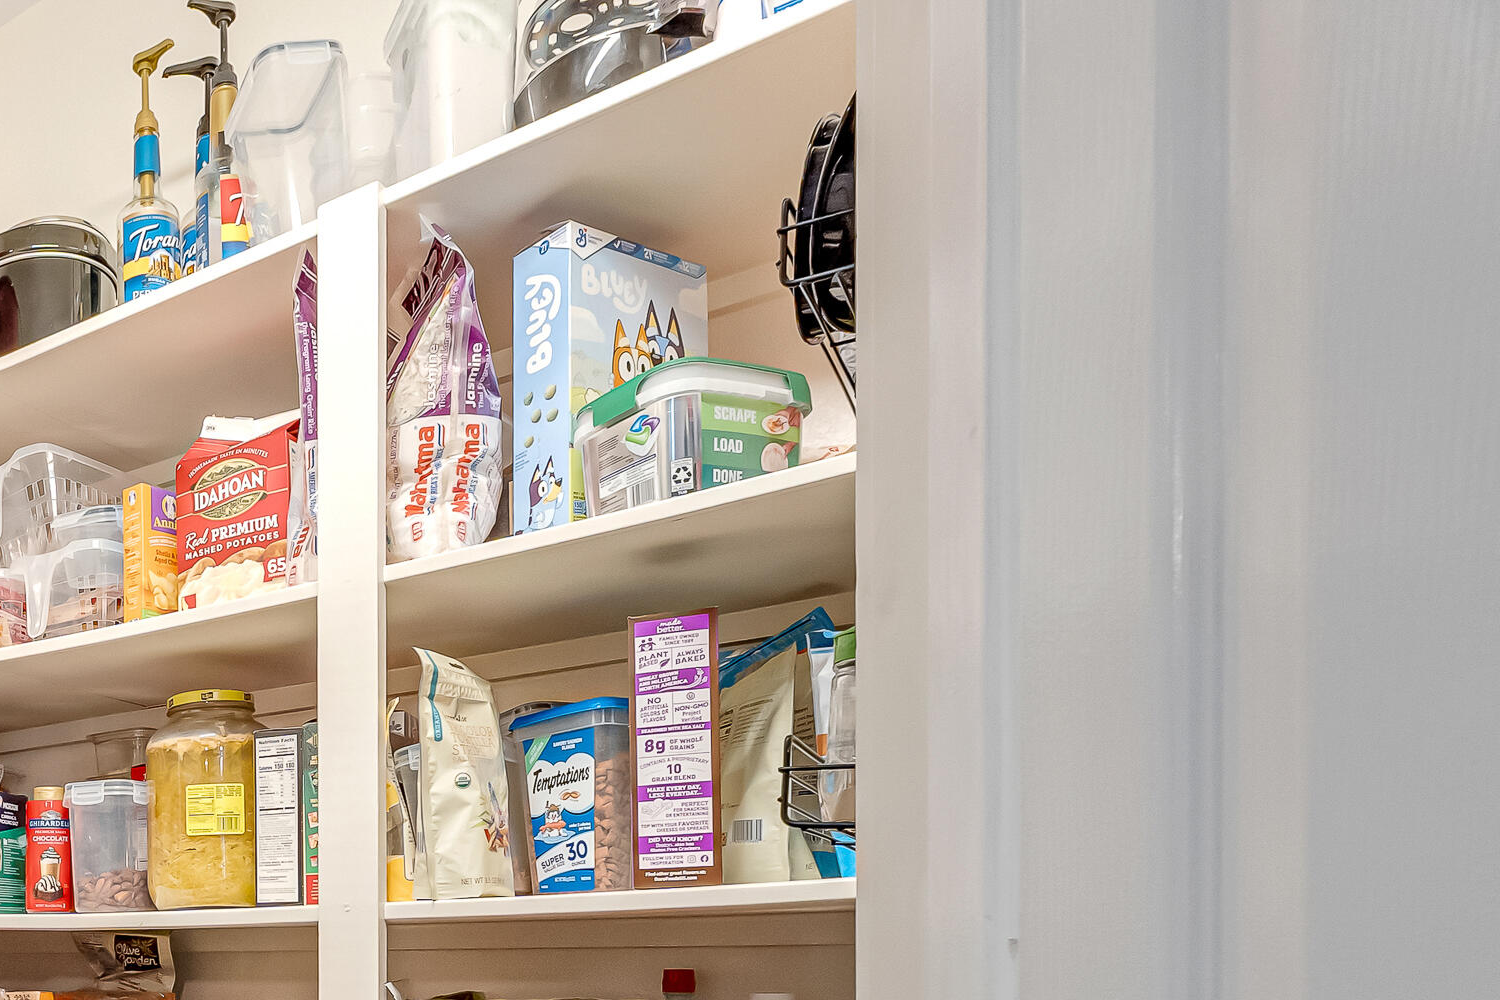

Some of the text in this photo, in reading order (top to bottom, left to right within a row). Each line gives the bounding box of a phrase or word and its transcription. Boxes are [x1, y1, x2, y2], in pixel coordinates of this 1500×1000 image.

[129, 223, 181, 262] Toran
[424, 343, 440, 409] Jasmine
[465, 341, 483, 409] Jasmine
[713, 405, 757, 425] SCRAPE
[243, 447, 269, 459] MINUTES
[713, 437, 744, 454] LOAD
[712, 468, 743, 484] DONE
[193, 470, 266, 512] IDAHOAN
[153, 516, 177, 531] Anni
[185, 514, 279, 551] Real PREMIUM
[185, 543, 223, 560] MASHED
[226, 531, 280, 551] POTATOES
[267, 558, 287, 573] 65
[638, 651, 668, 663] PLANT
[675, 654, 706, 664] BAKED
[677, 648, 704, 657] ALWAYS
[647, 697, 661, 705] NO
[674, 701, 709, 712] NON-GMO
[644, 739, 666, 754] 8g
[666, 763, 682, 775] 10
[532, 766, 590, 795] Temptations
[29, 819, 70, 828] GHIRARDEL
[32, 835, 69, 843] CHOCOLATE
[566, 840, 588, 861] 30
[541, 853, 565, 869] SUPER
[115, 943, 141, 956] Olive
[117, 952, 159, 967] Garden
